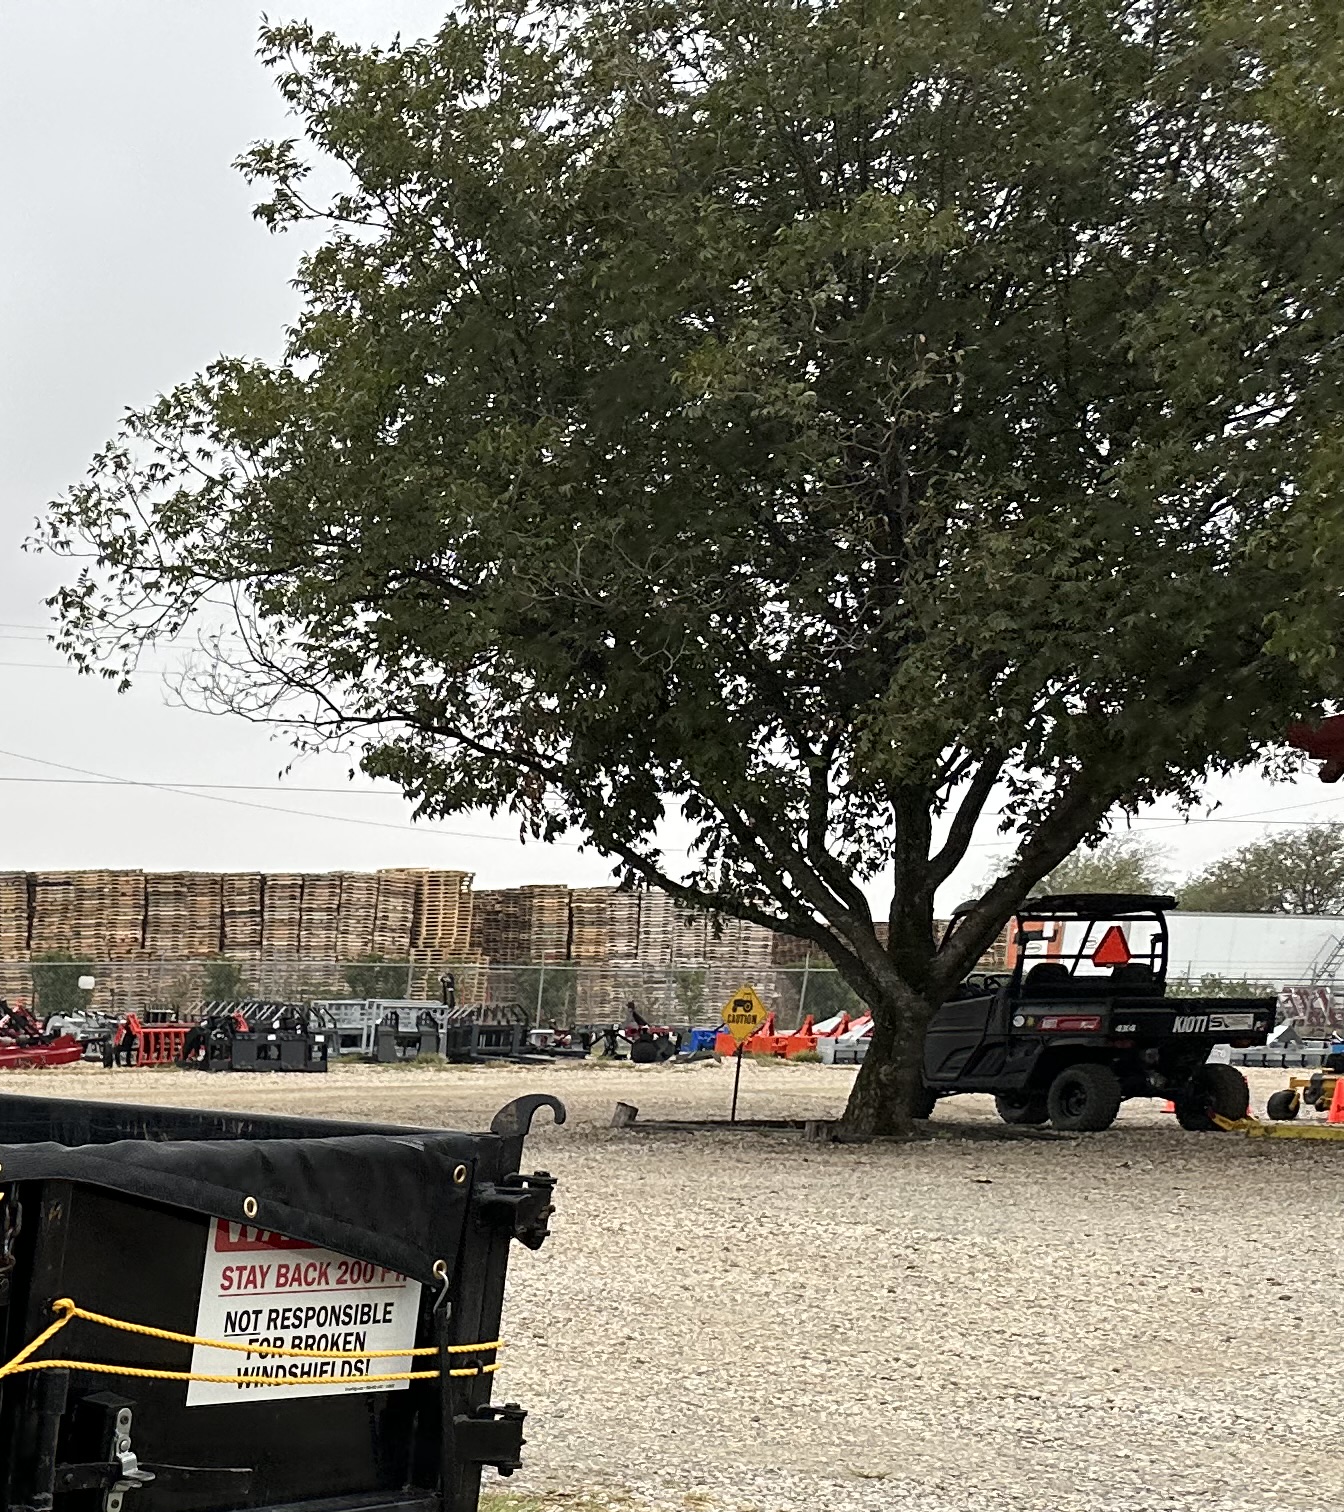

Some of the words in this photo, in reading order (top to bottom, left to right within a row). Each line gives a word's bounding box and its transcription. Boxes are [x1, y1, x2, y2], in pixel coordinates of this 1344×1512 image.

[727, 1014, 757, 1024] CAUTION
[1172, 1016, 1208, 1032] KIOTI
[220, 1264, 271, 1291] STAY
[275, 1262, 332, 1288] BACK
[336, 1261, 375, 1285] 200
[224, 1310, 263, 1335] NOT
[266, 1302, 395, 1330] RESPONSIBLE
[246, 1336, 285, 1361] FOR
[290, 1331, 367, 1357] BROKEN
